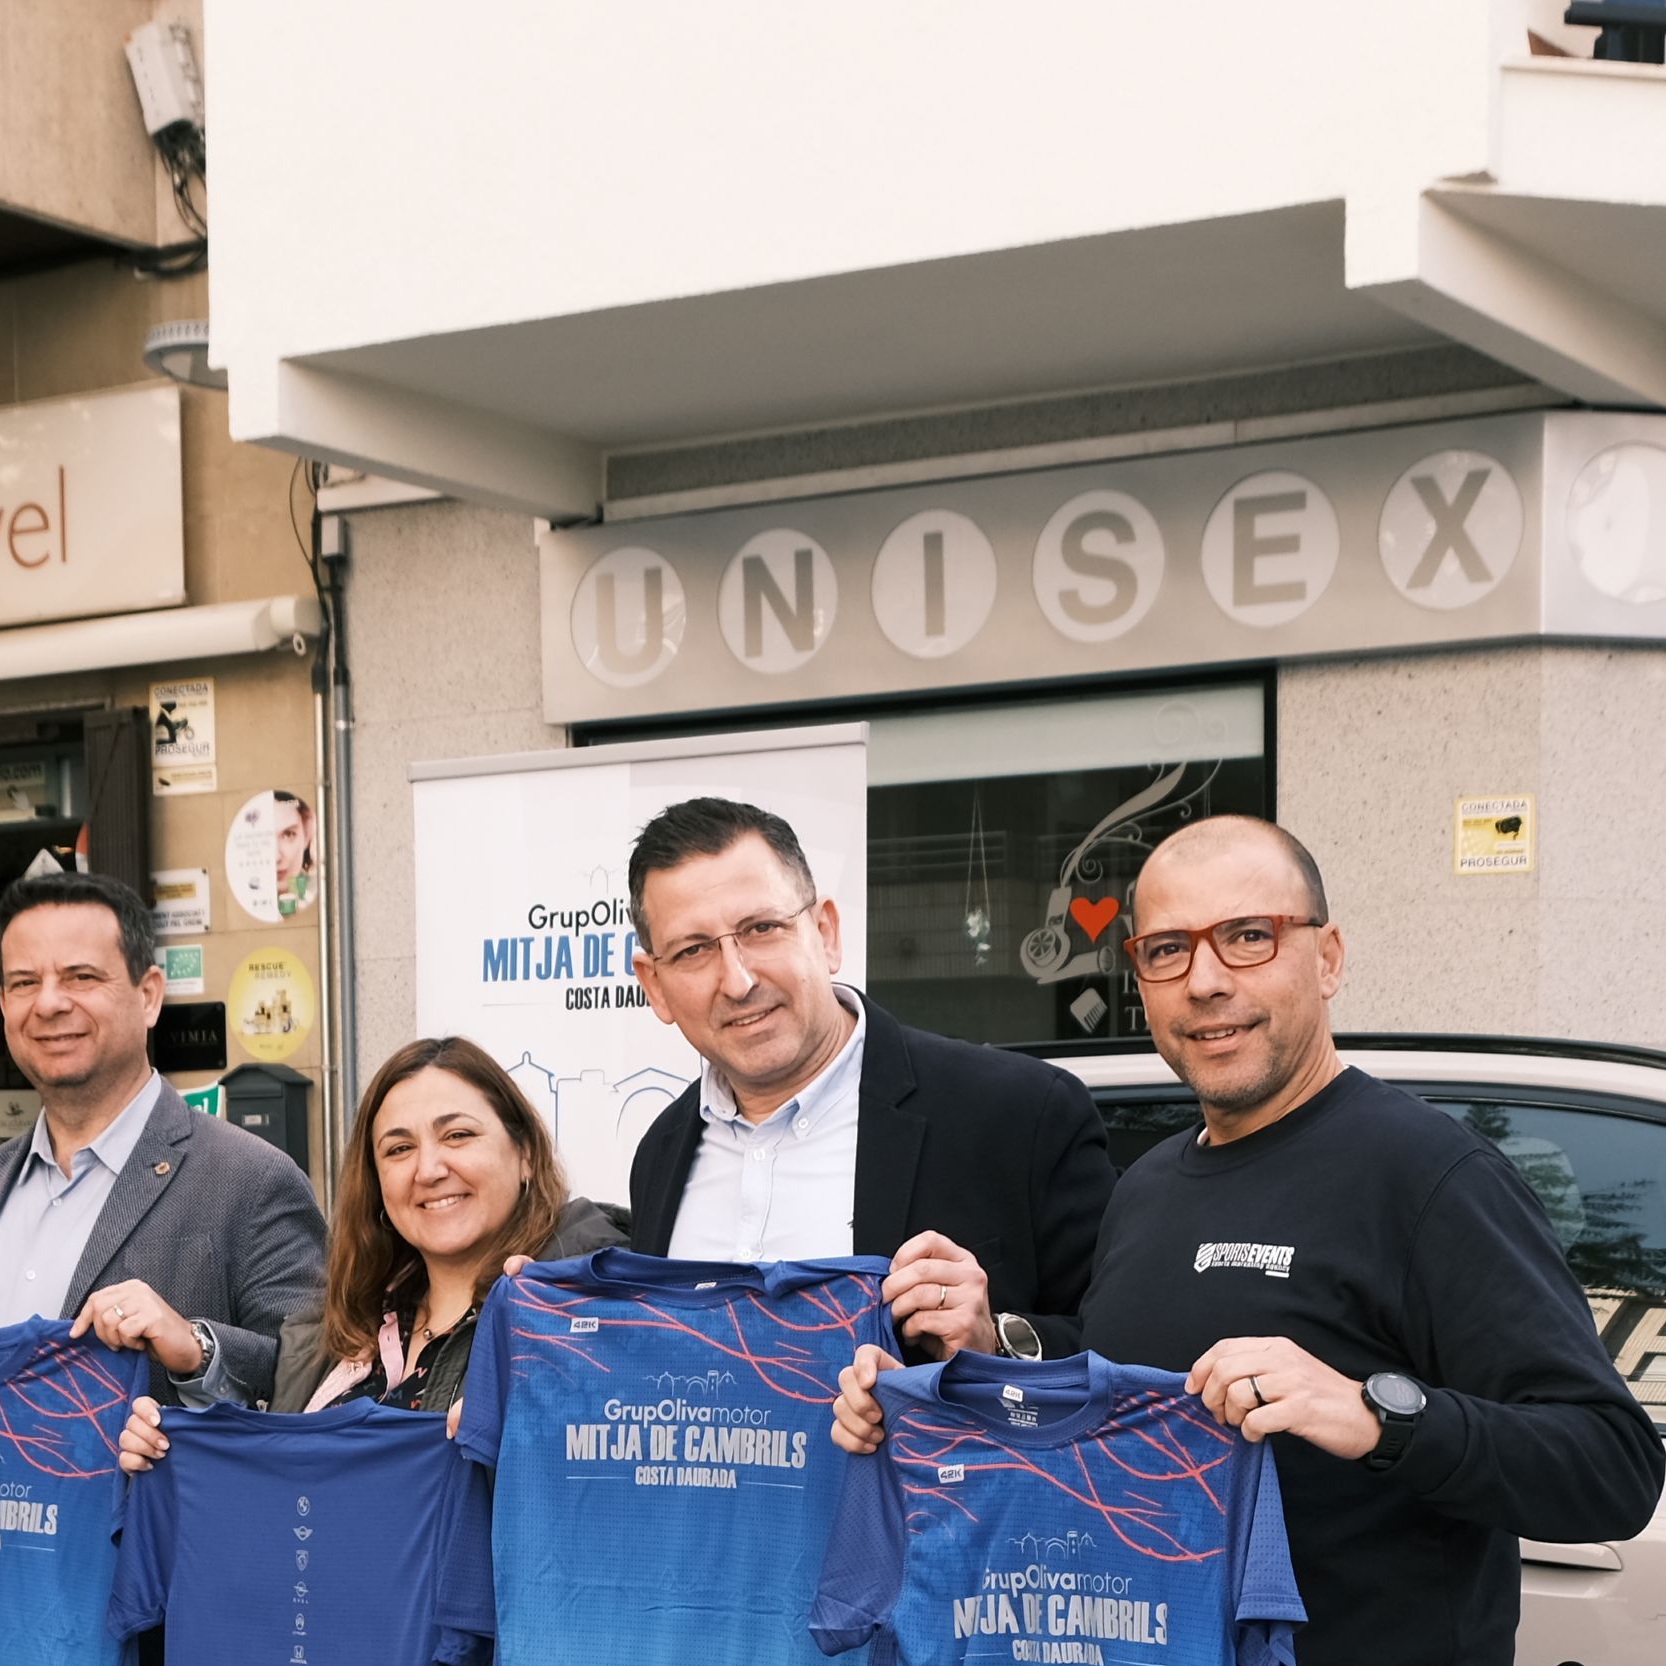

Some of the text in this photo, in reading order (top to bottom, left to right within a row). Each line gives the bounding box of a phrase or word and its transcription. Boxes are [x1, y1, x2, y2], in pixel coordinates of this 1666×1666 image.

[594, 467, 1493, 676] UNISEX
[1460, 855, 1527, 868] PROSEGUR
[248, 962, 284, 971] RESCUE
[482, 935, 573, 983] MITJA
[582, 932, 615, 979] DE
[565, 985, 611, 1011] COSTA
[604, 1398, 771, 1428] GrupOlivamotor
[566, 1425, 807, 1468] MITJA DE CAMBRILS
[635, 1466, 737, 1489] COSTA DAURADA
[1047, 1595, 1168, 1646] CAMBRILS
